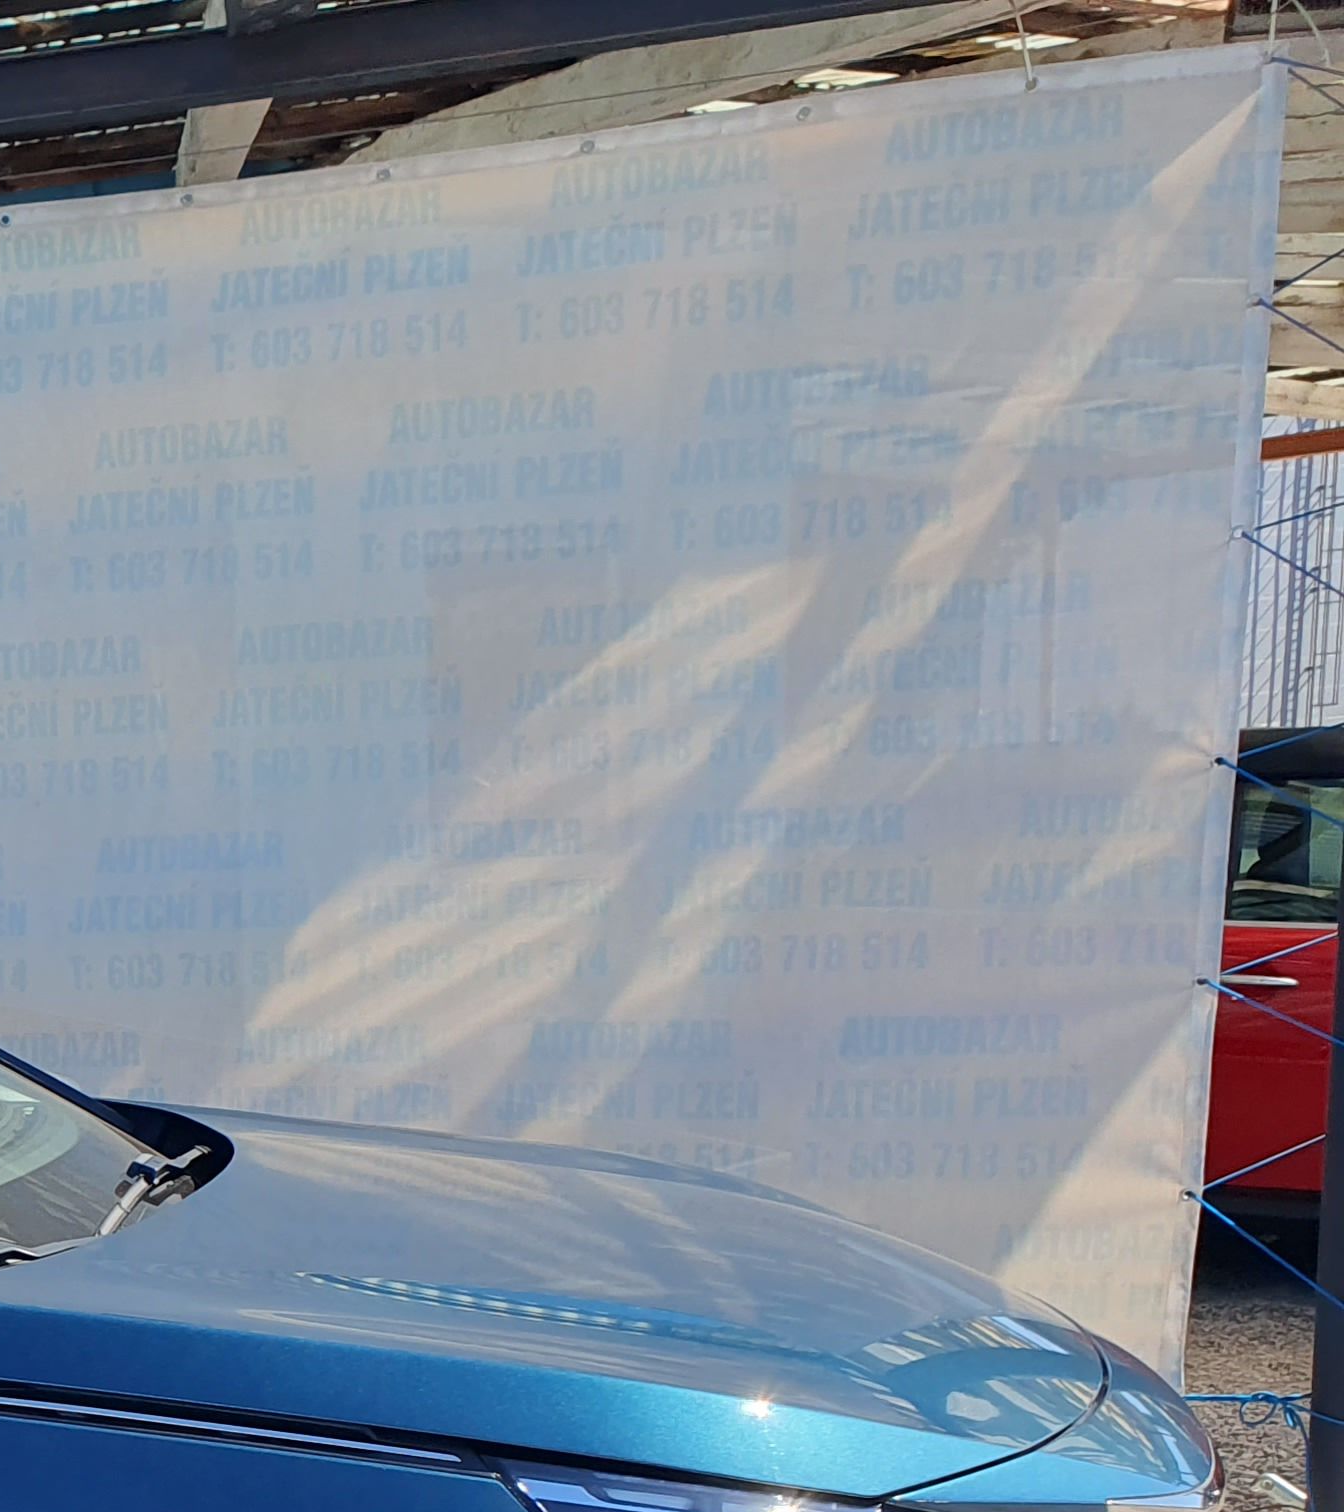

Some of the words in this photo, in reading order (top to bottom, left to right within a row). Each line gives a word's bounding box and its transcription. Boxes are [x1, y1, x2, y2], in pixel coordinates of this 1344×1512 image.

[887, 95, 1123, 164] AUTOBAZAR
[550, 149, 768, 209] AUTOBAZAR
[242, 185, 442, 246] AUTOBAZAR
[895, 254, 963, 302] 603
[986, 246, 1055, 292] 718
[560, 292, 624, 340] 603
[644, 281, 708, 329] 718
[727, 273, 793, 321] 514
[38, 349, 95, 390] 718
[109, 342, 168, 384] 514
[213, 333, 235, 373] T:
[252, 326, 311, 368] 603
[328, 319, 389, 361] 718
[406, 310, 468, 354] 514
[95, 416, 289, 470] AUTOBAZAR
[389, 386, 595, 445] AUTOBAZAR
[111, 550, 165, 592] 603
[183, 544, 238, 586] 718
[255, 539, 310, 580] 514
[400, 528, 462, 568] 603
[477, 523, 540, 564] 718
[557, 517, 622, 560] 514
[43, 758, 98, 797] 718
[113, 753, 168, 792] 514
[839, 1014, 1061, 1057] AUTOBAZAR
